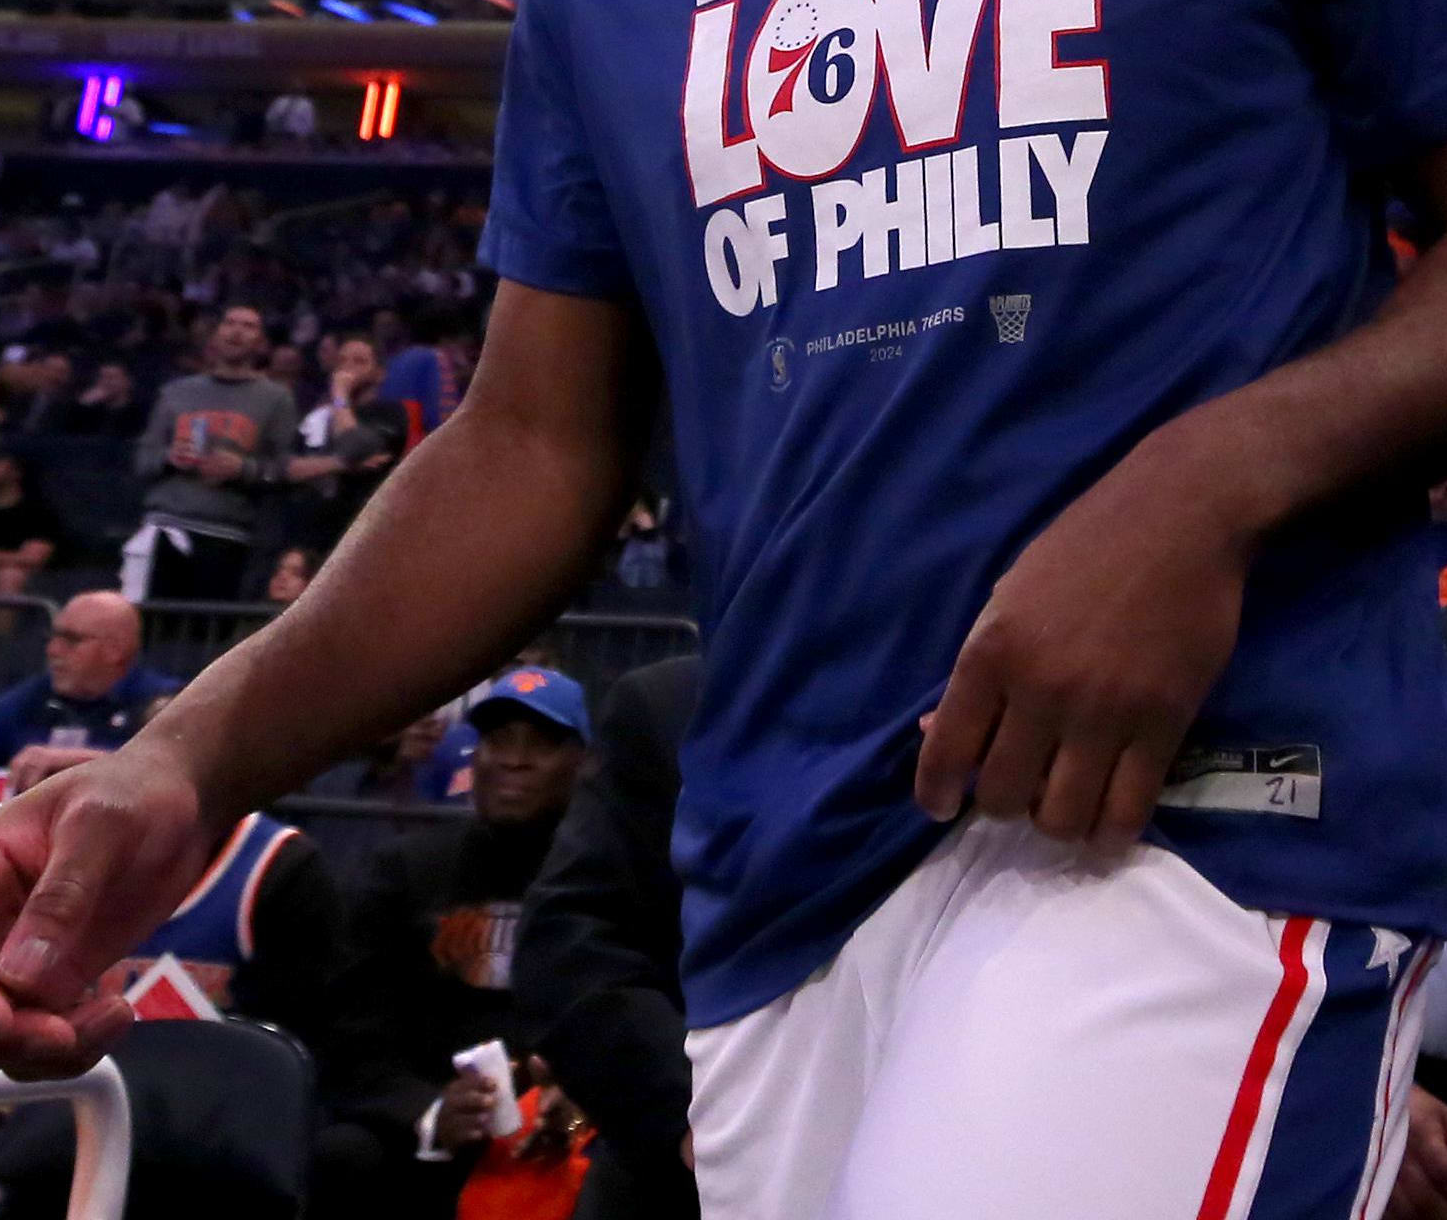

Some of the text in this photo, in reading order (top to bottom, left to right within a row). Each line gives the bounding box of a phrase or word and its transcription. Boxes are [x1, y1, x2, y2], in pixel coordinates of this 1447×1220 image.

[767, 26, 856, 118] 76
[704, 130, 1109, 317] OF PHILLY
[806, 305, 965, 357] PHILADELPHIA 76ERS
[869, 345, 904, 363] 2024
[1265, 776, 1297, 806] 21
